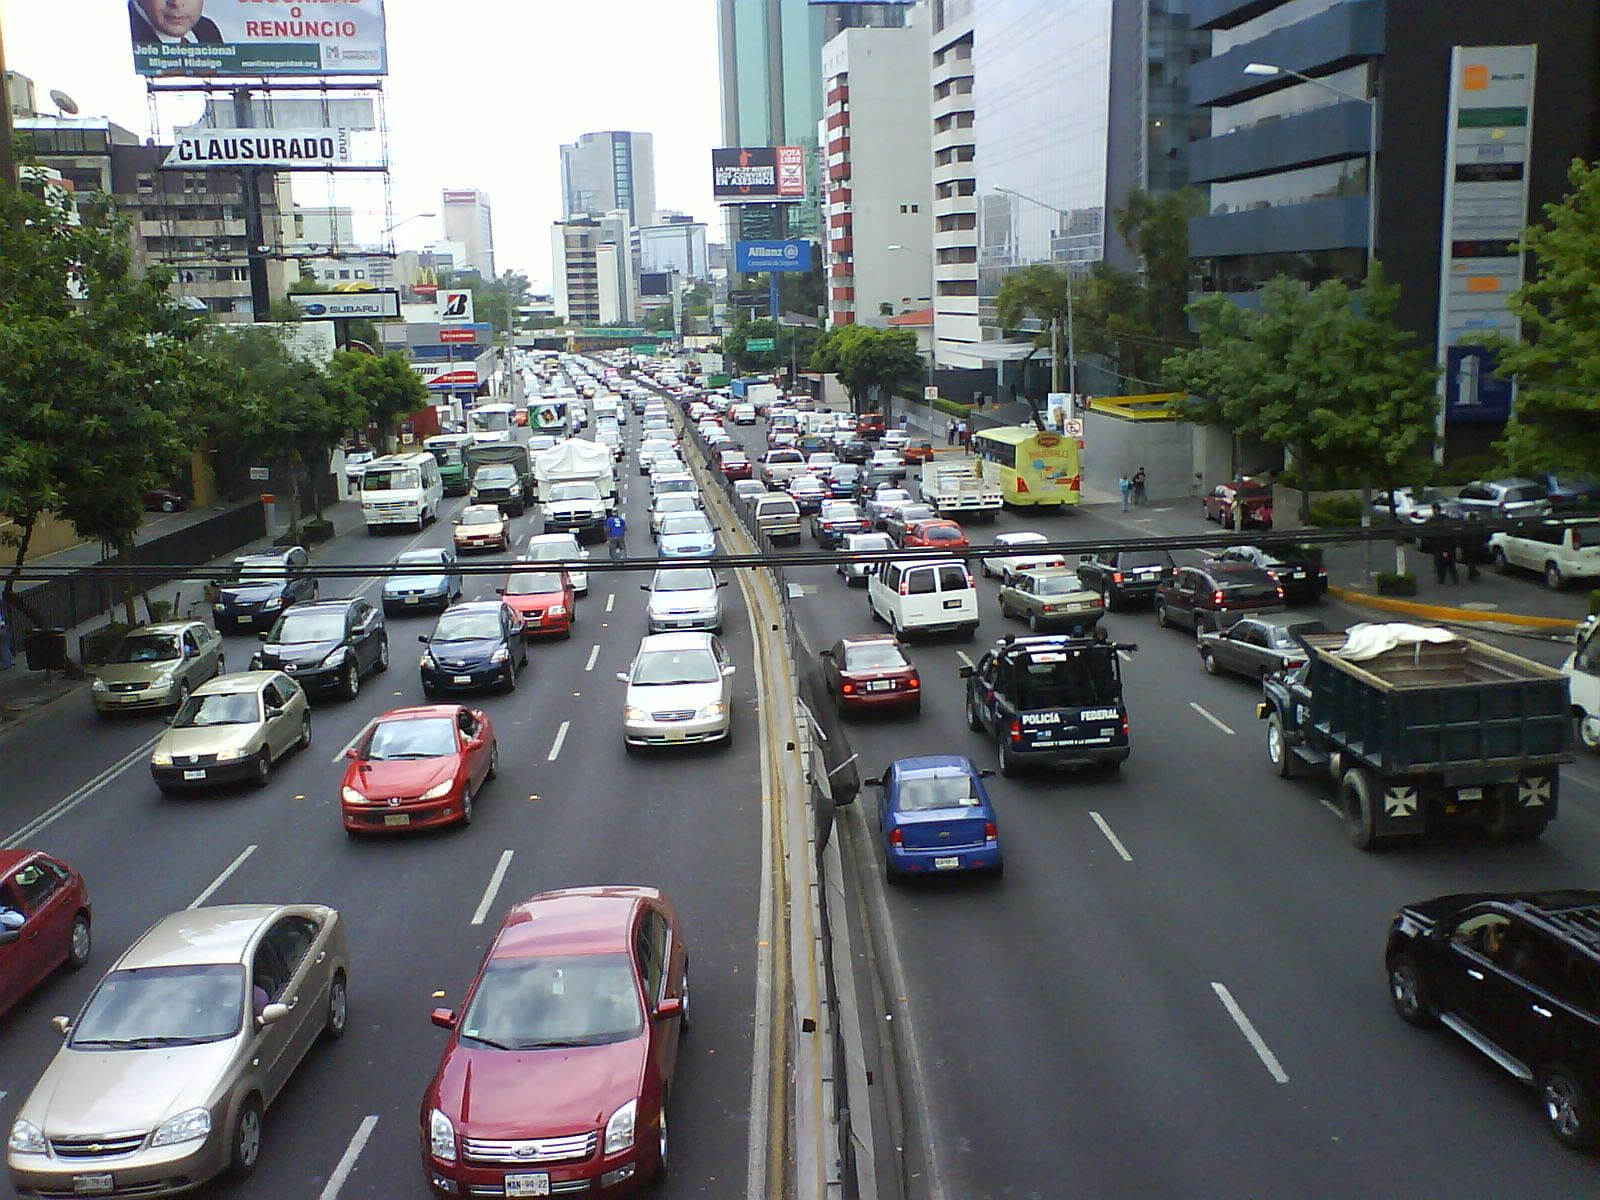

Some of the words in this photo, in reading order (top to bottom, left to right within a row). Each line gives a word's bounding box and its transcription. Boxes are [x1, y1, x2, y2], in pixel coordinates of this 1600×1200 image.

[290, 6, 302, 18] O
[246, 20, 356, 37] RENUNCIO
[134, 45, 159, 56] Jefe
[161, 45, 236, 58] Delegacional
[149, 58, 182, 69] Miguel
[184, 58, 222, 69] Hidalgo
[178, 137, 334, 161] CLAUSURADO
[338, 127, 348, 162] EDUVI
[748, 247, 783, 256] Allianz
[329, 305, 380, 314] SUBARU
[1022, 712, 1061, 725] POLICÍA
[1080, 709, 1119, 721] FEDERAL
